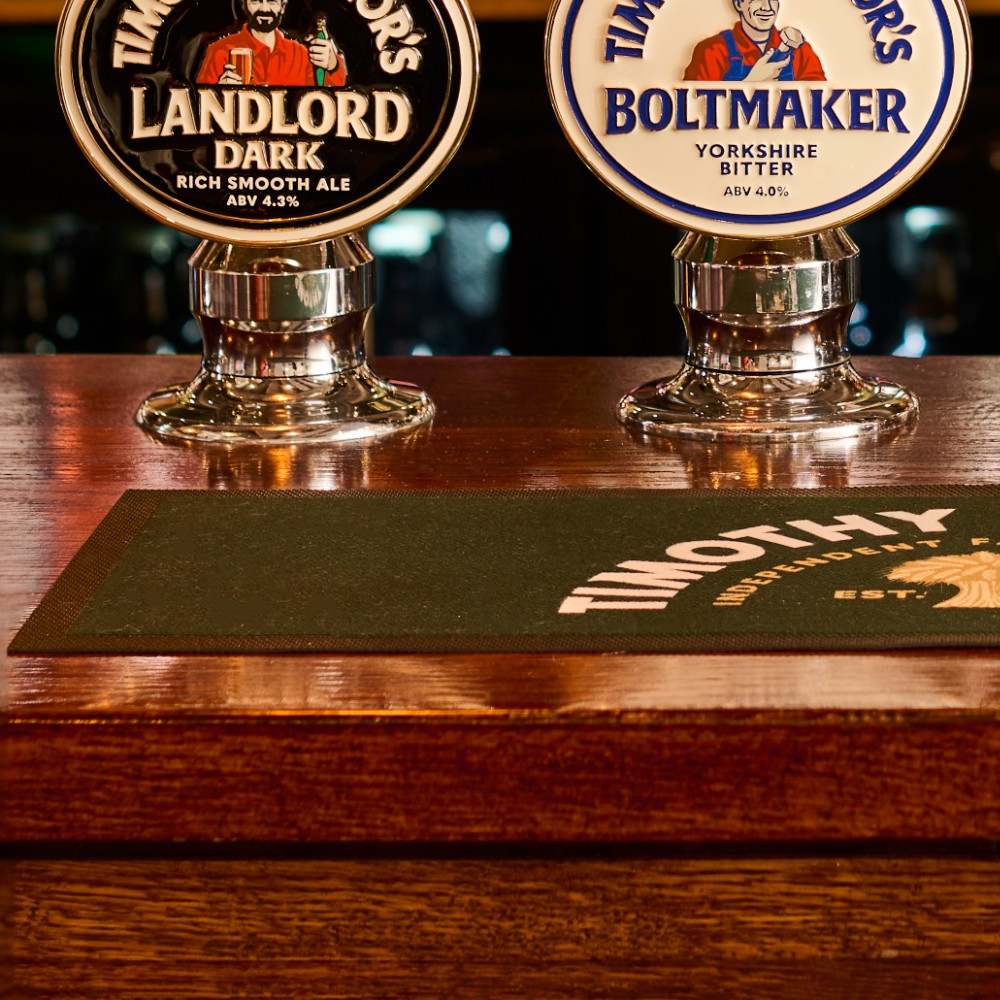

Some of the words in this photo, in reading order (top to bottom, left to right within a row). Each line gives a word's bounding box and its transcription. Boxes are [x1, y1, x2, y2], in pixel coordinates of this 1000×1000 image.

[129, 86, 411, 142] LANDLORD
[605, 87, 910, 135] BOLTMAKER
[215, 141, 324, 170] DARK
[696, 143, 818, 159] YORKSHIRE
[720, 162, 794, 176] BITTER
[176, 175, 221, 190] RICH
[227, 176, 309, 192] SMOOTH
[316, 177, 350, 192] ALE
[724, 186, 752, 197] ABV
[755, 185, 789, 197] 4.0%
[226, 195, 258, 207] ABV
[262, 195, 300, 207] 4.3%
[557, 508, 957, 614] TIMOTHY
[712, 539, 942, 606] INDEPENDENT
[833, 589, 927, 600] EST.
